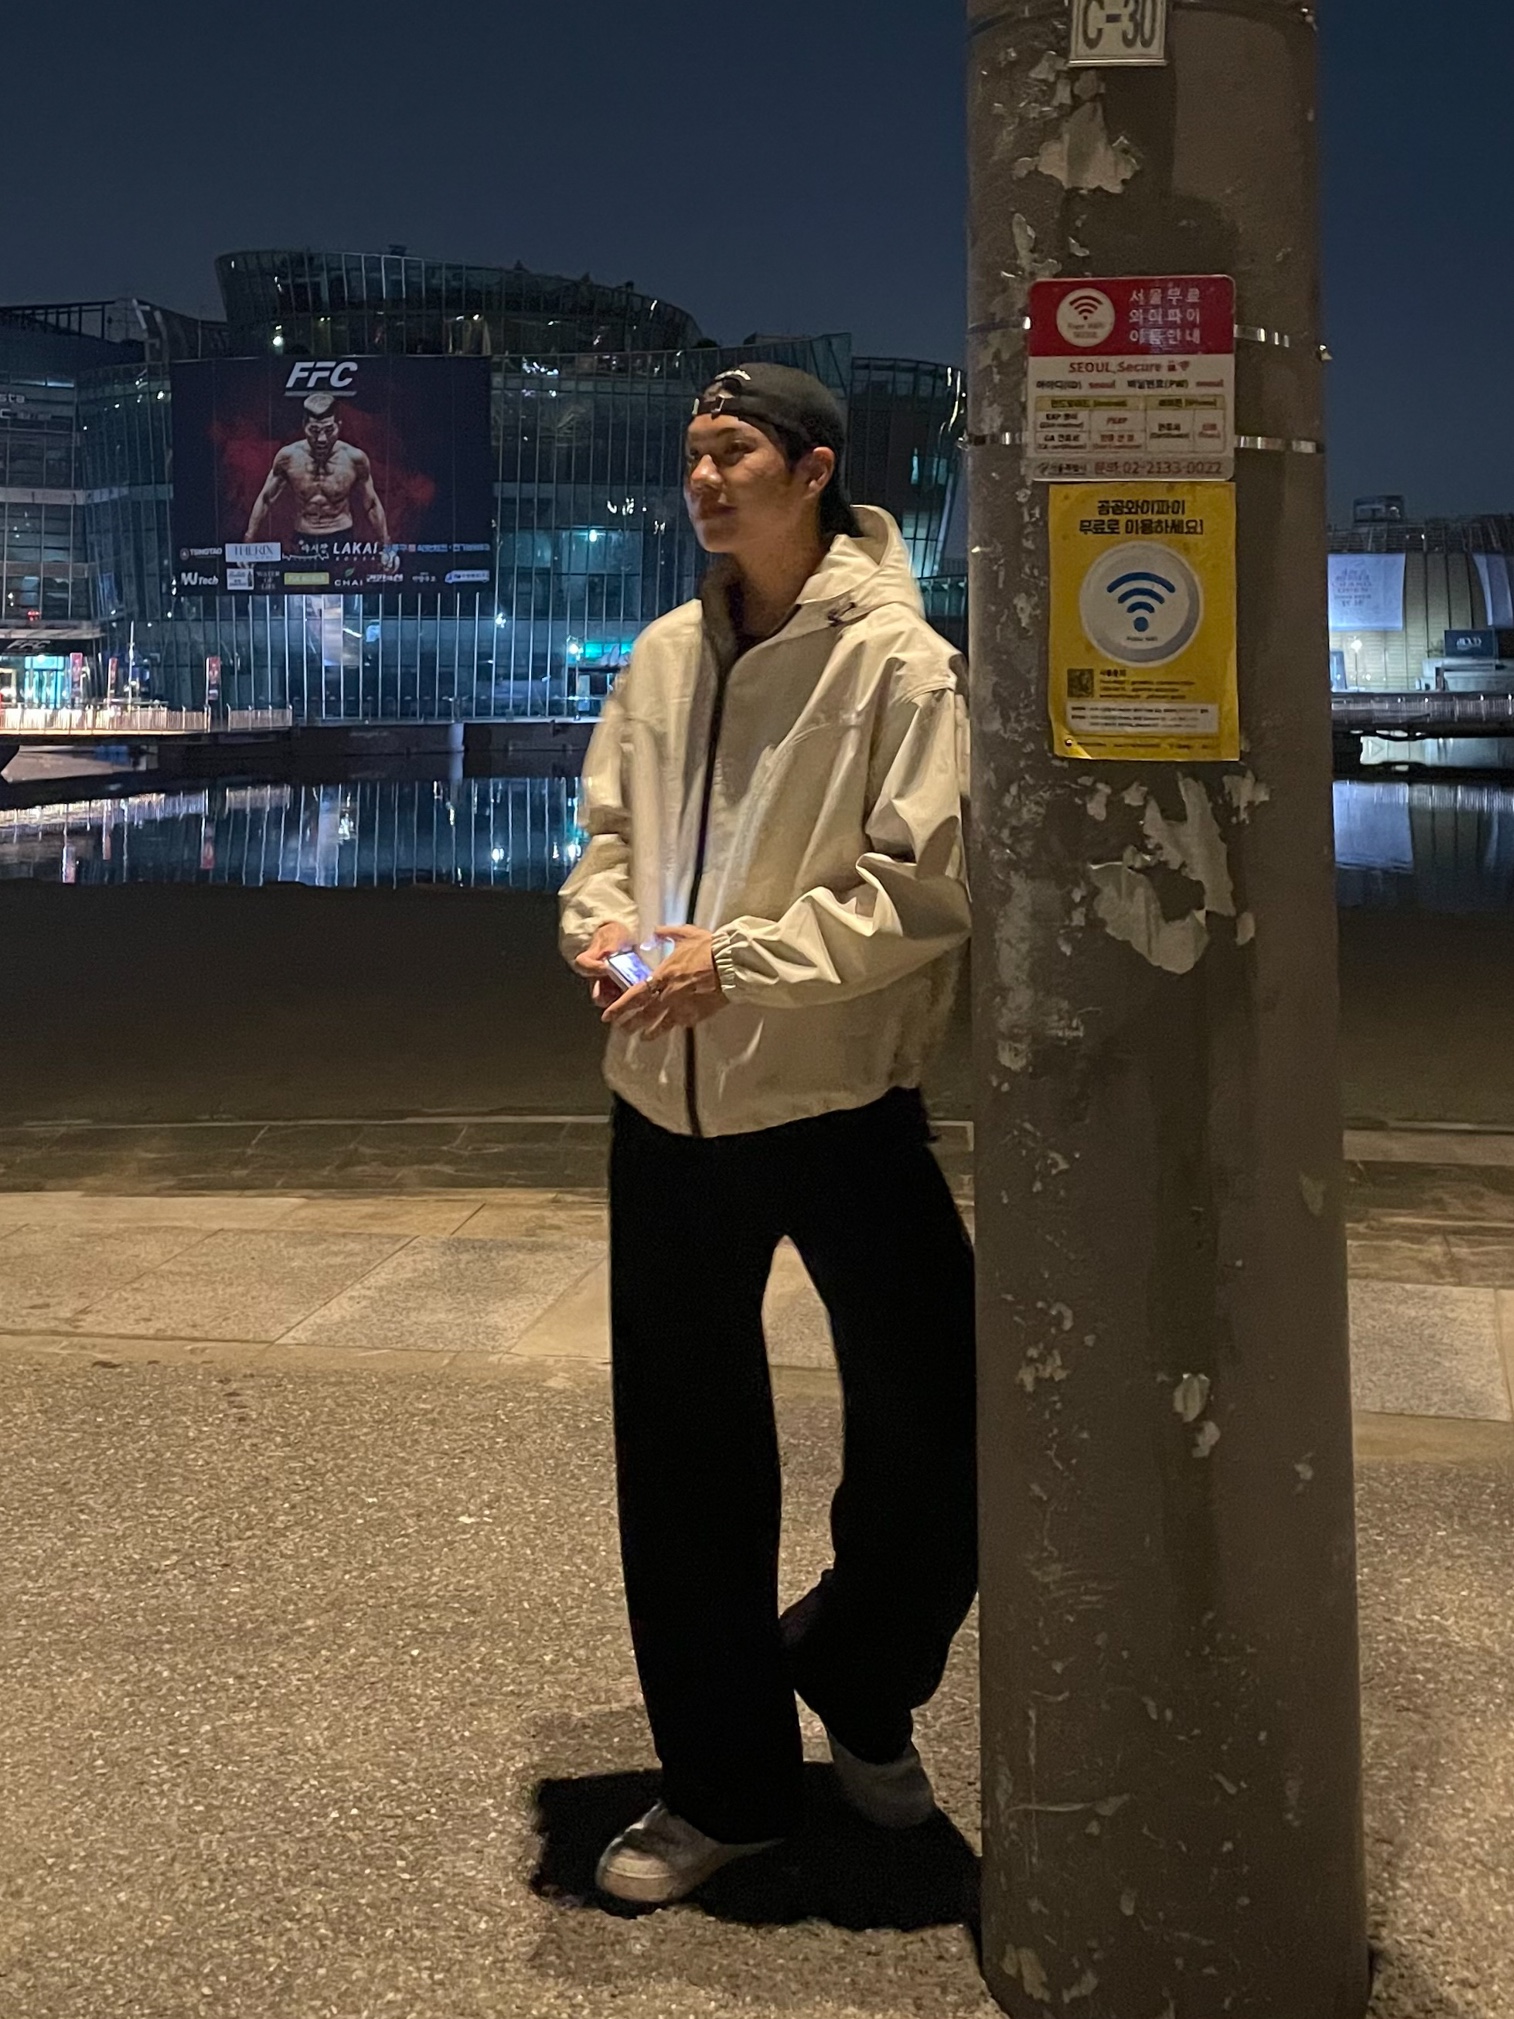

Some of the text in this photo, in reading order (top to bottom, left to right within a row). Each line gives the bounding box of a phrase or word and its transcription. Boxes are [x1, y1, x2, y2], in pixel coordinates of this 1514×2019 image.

[1082, 0, 1156, 49] C-30
[285, 361, 358, 388] FFC
[1097, 499, 1186, 516] 공공와이파이
[1079, 519, 1121, 535] 무료로
[333, 541, 378, 555] LAKAI
[334, 579, 363, 587] CHAI
